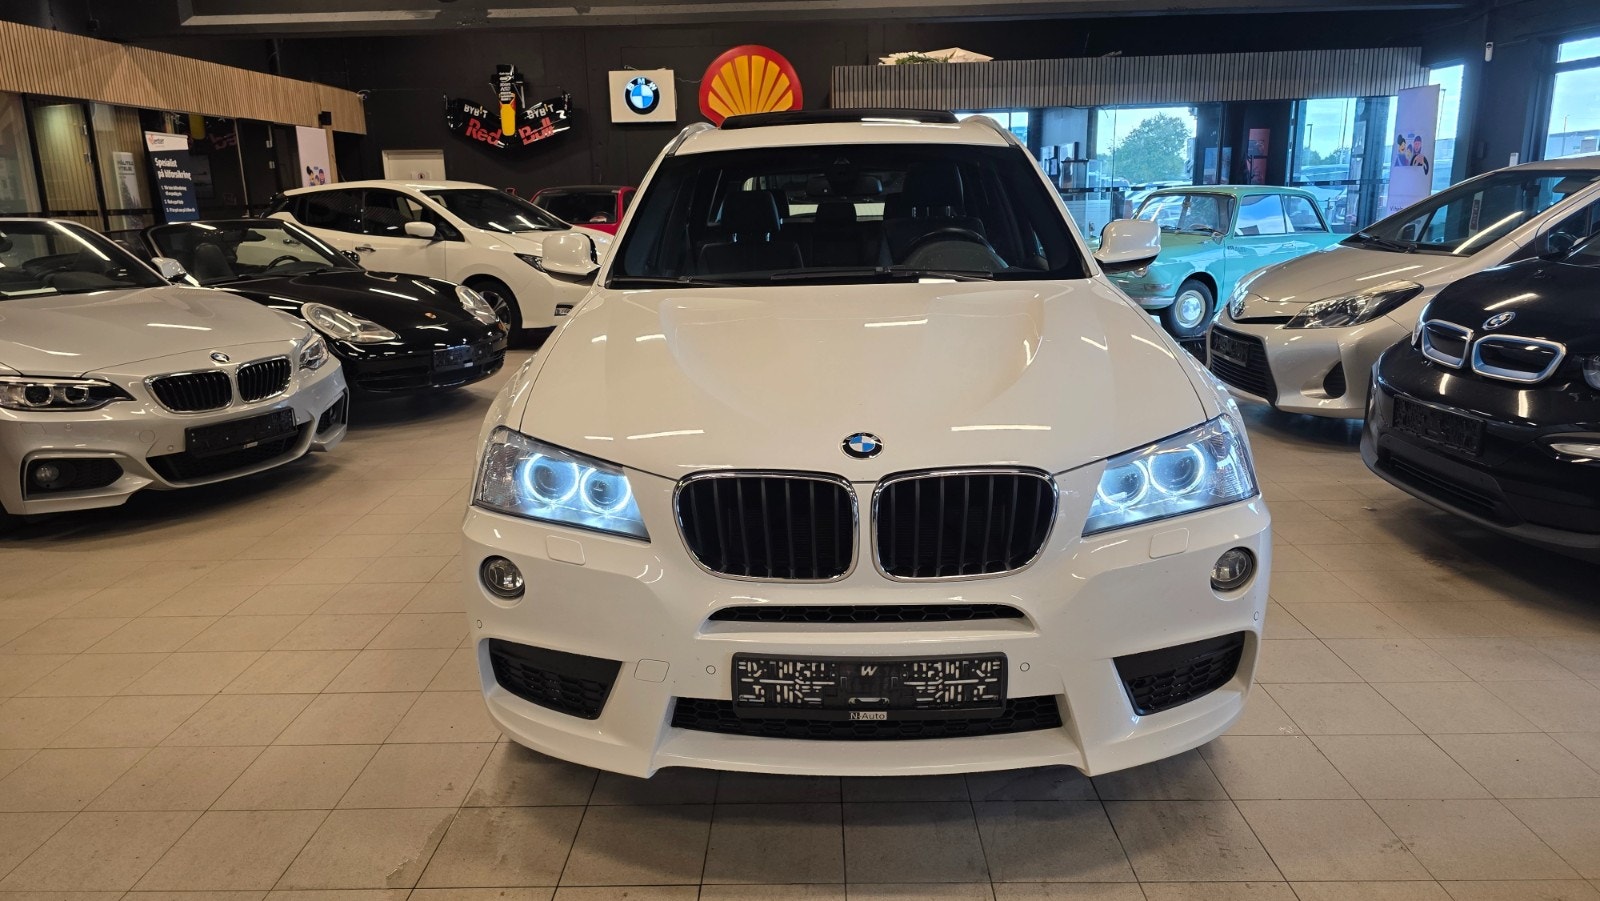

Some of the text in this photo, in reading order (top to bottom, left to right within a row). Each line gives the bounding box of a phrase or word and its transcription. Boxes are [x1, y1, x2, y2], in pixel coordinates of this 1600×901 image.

[626, 77, 658, 91] BMW
[465, 116, 556, 146] Red Bull
